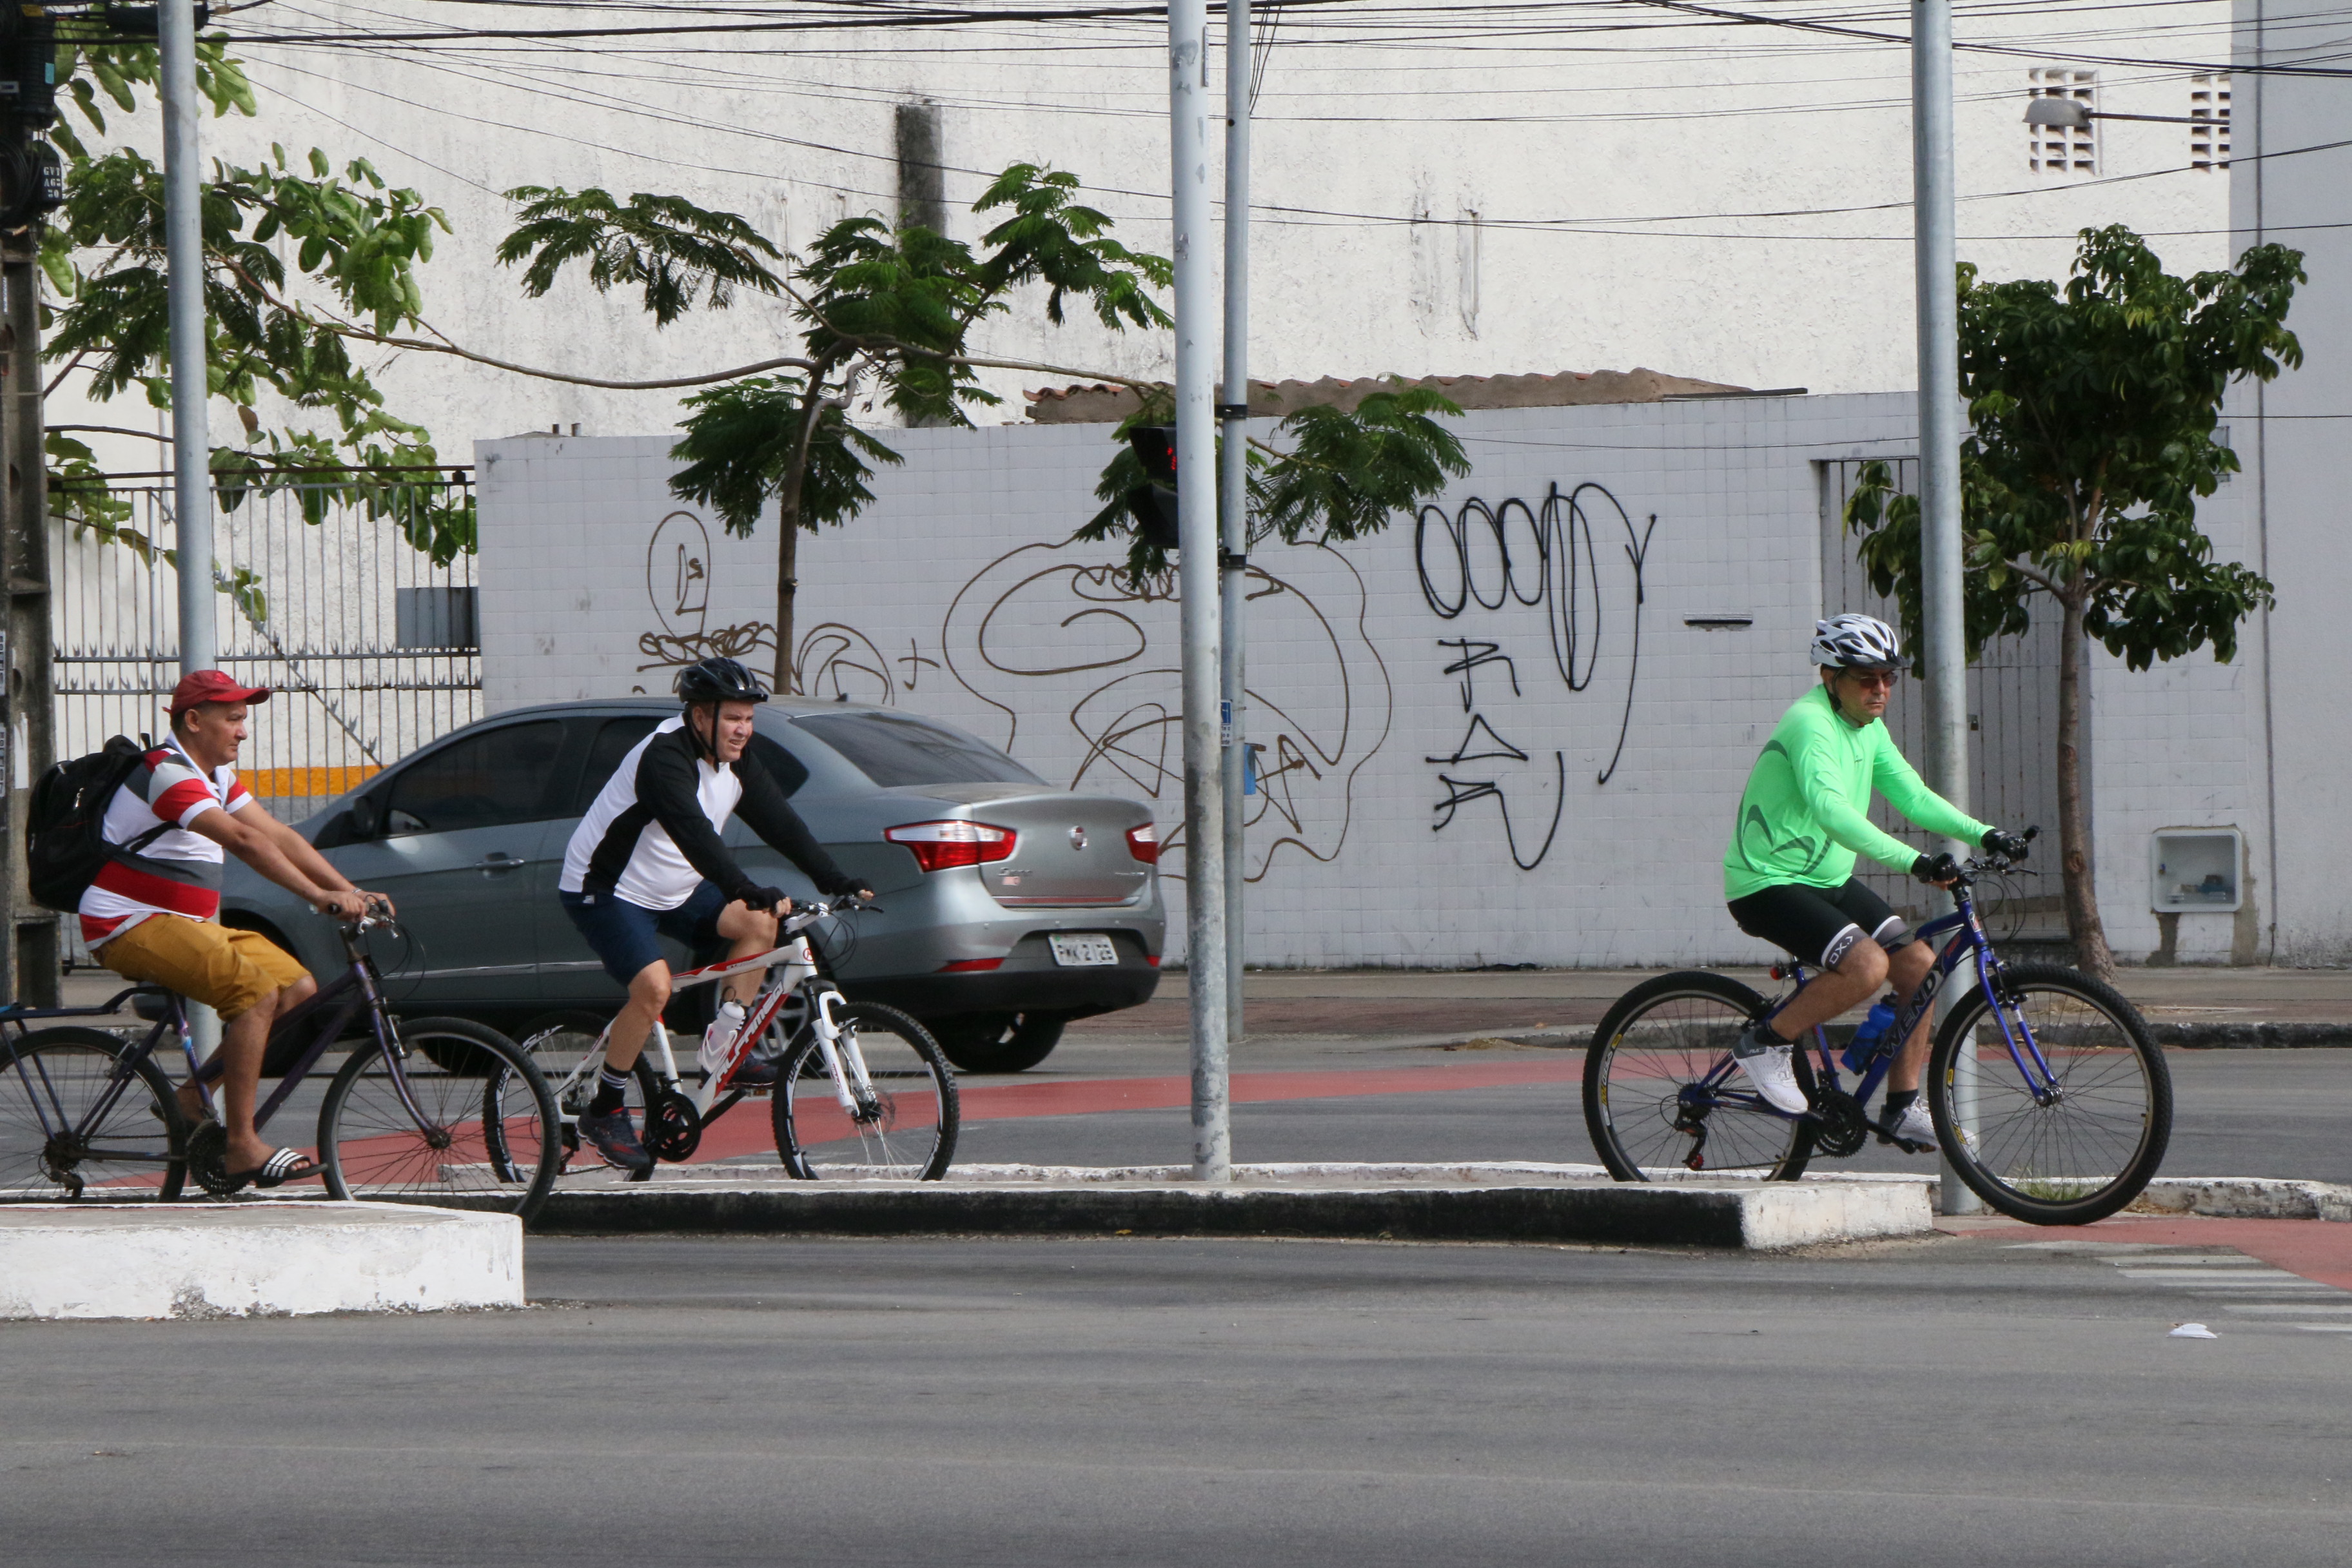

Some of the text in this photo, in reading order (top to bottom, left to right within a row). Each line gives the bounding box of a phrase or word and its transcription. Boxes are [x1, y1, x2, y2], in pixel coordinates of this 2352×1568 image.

[43, 166, 60, 176] GVT
[1879, 956, 1946, 1059] WENDY
[1947, 1086, 1959, 1126] SPEED
